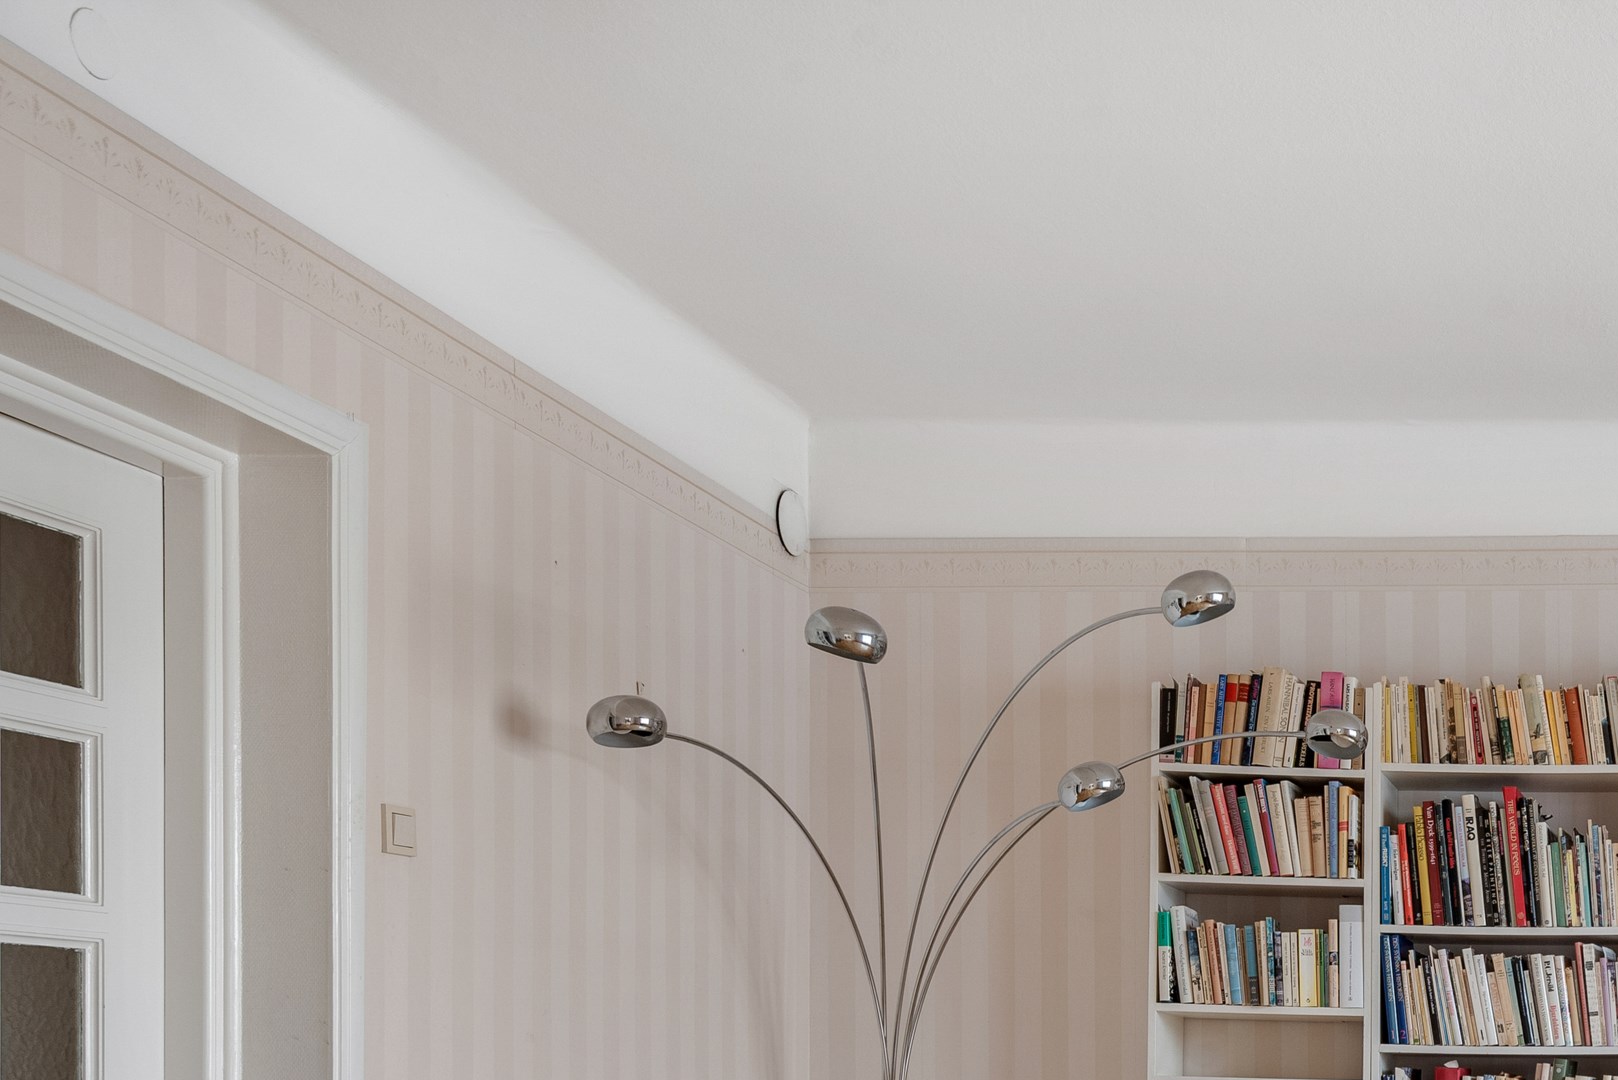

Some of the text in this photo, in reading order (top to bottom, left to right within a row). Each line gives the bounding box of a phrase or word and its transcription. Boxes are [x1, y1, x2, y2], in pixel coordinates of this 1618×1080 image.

[1426, 805, 1434, 819] Van
[1507, 800, 1515, 814] THE
[1415, 814, 1426, 862] Pablo Picasso
[1427, 820, 1436, 837] Dyck
[1465, 816, 1477, 842] IRAQ
[1508, 815, 1518, 842] WORLD
[1383, 950, 1391, 973] SVENSKA
[1392, 950, 1400, 973] SVENSKA
